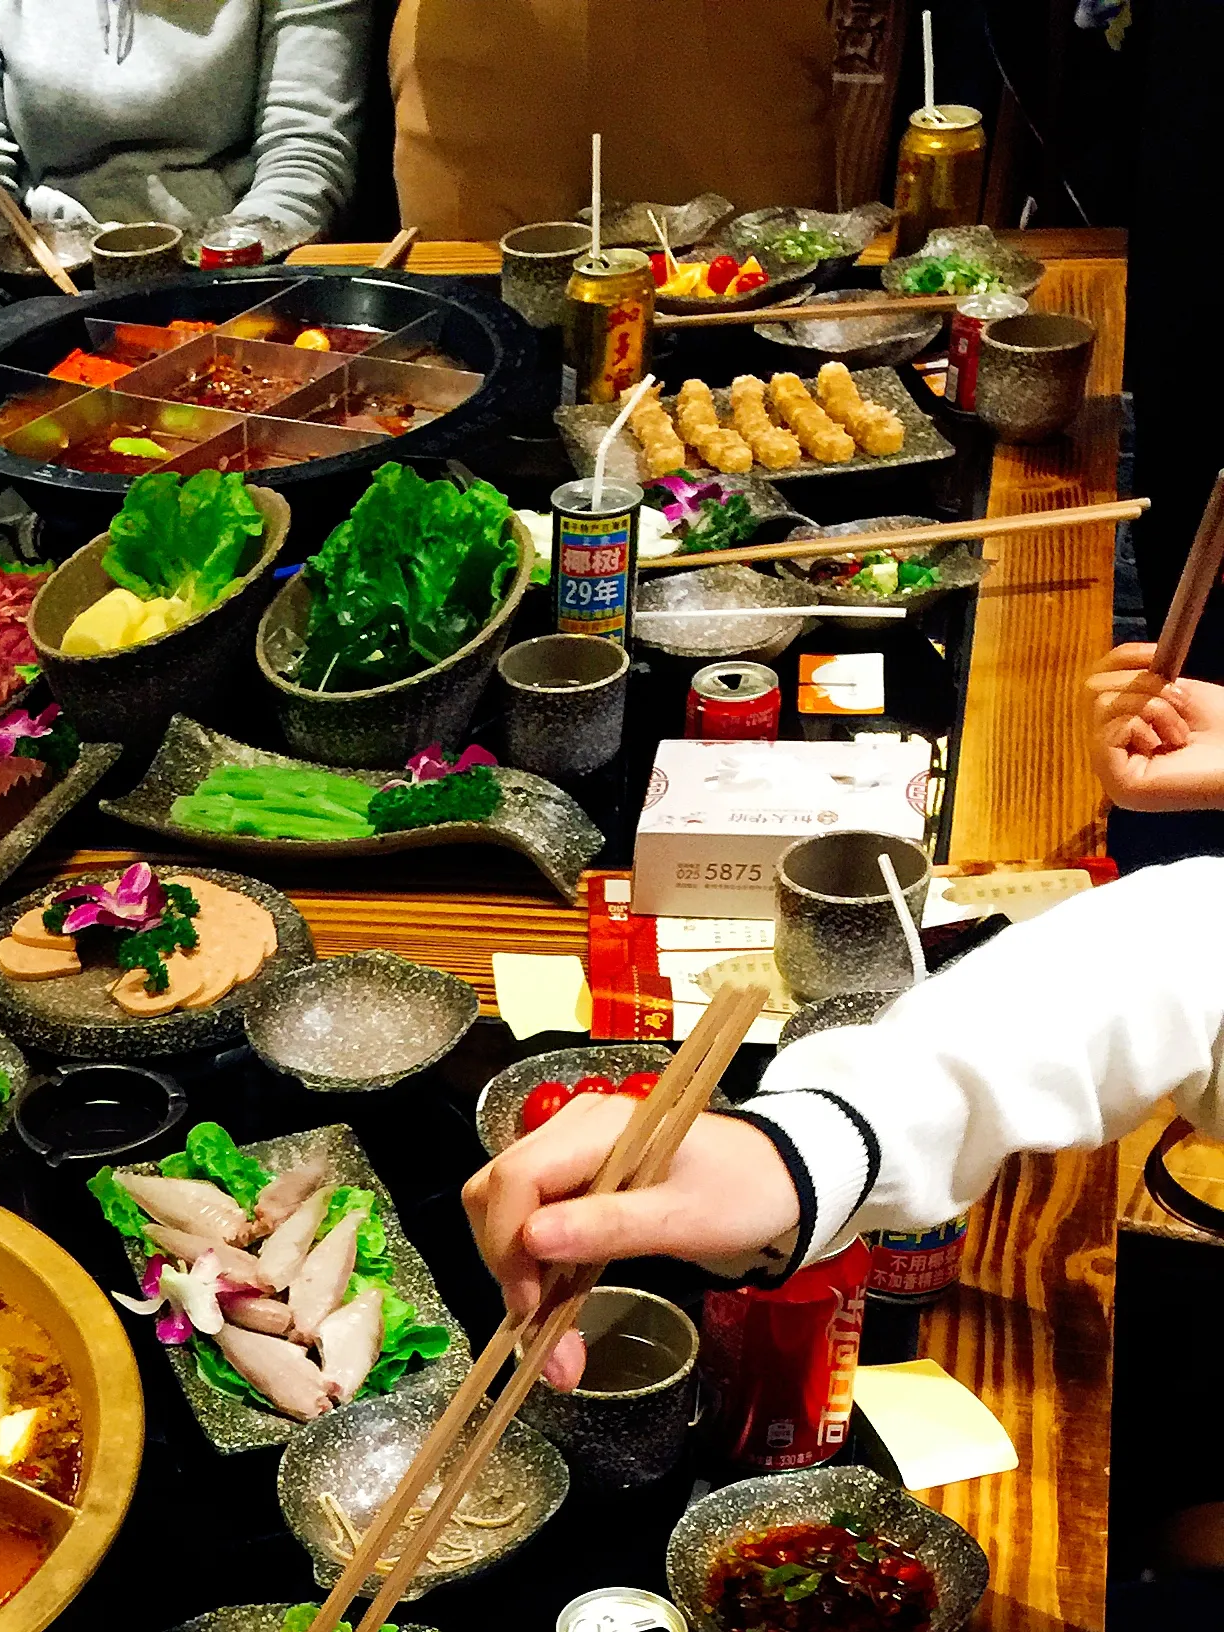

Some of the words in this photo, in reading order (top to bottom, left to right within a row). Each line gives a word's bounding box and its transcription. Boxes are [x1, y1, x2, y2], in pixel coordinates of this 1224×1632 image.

[563, 547, 622, 574] 椰树
[565, 579, 620, 605] 29年
[704, 863, 762, 882] 5875
